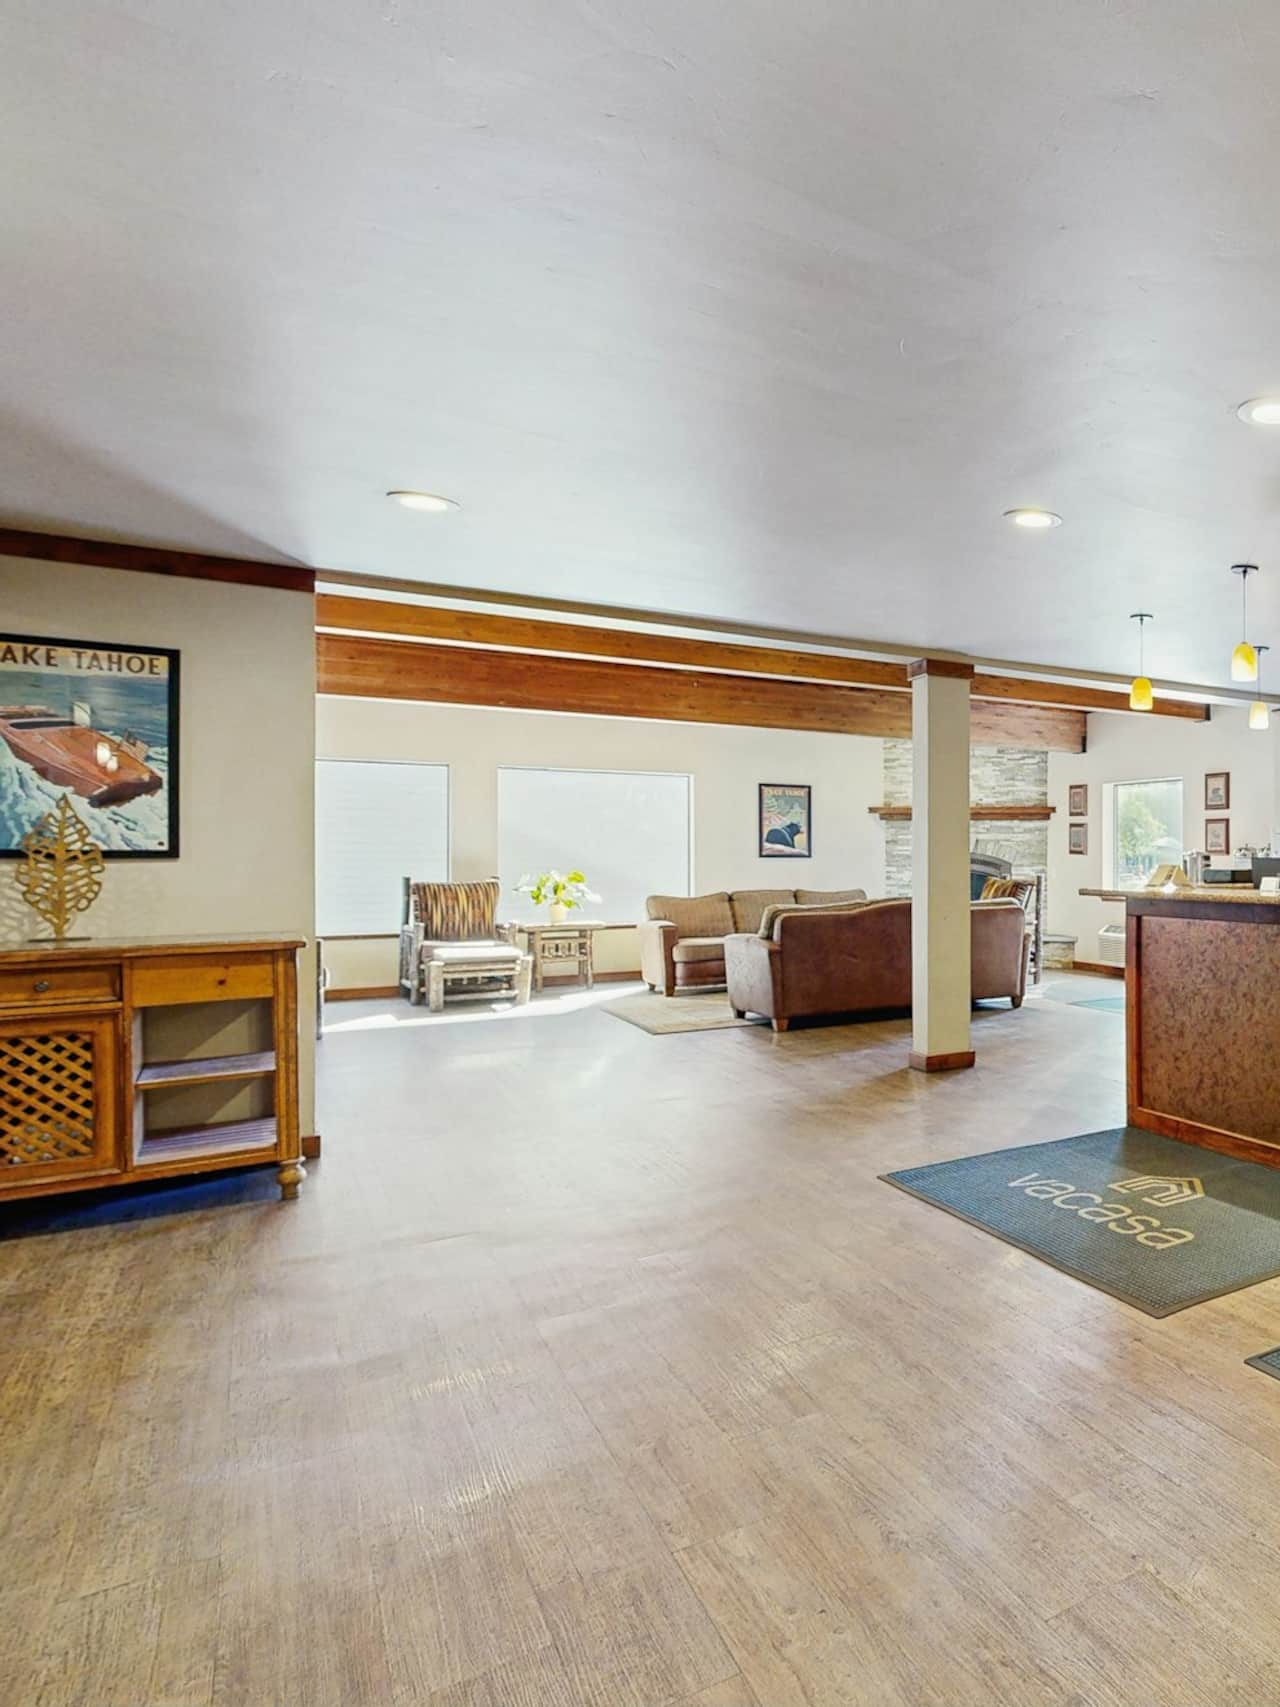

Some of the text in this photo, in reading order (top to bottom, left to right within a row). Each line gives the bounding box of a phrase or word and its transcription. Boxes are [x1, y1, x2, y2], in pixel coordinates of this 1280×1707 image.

[0, 645, 161, 676] AKE TAHOE
[1007, 1172, 1195, 1250] vacasa
